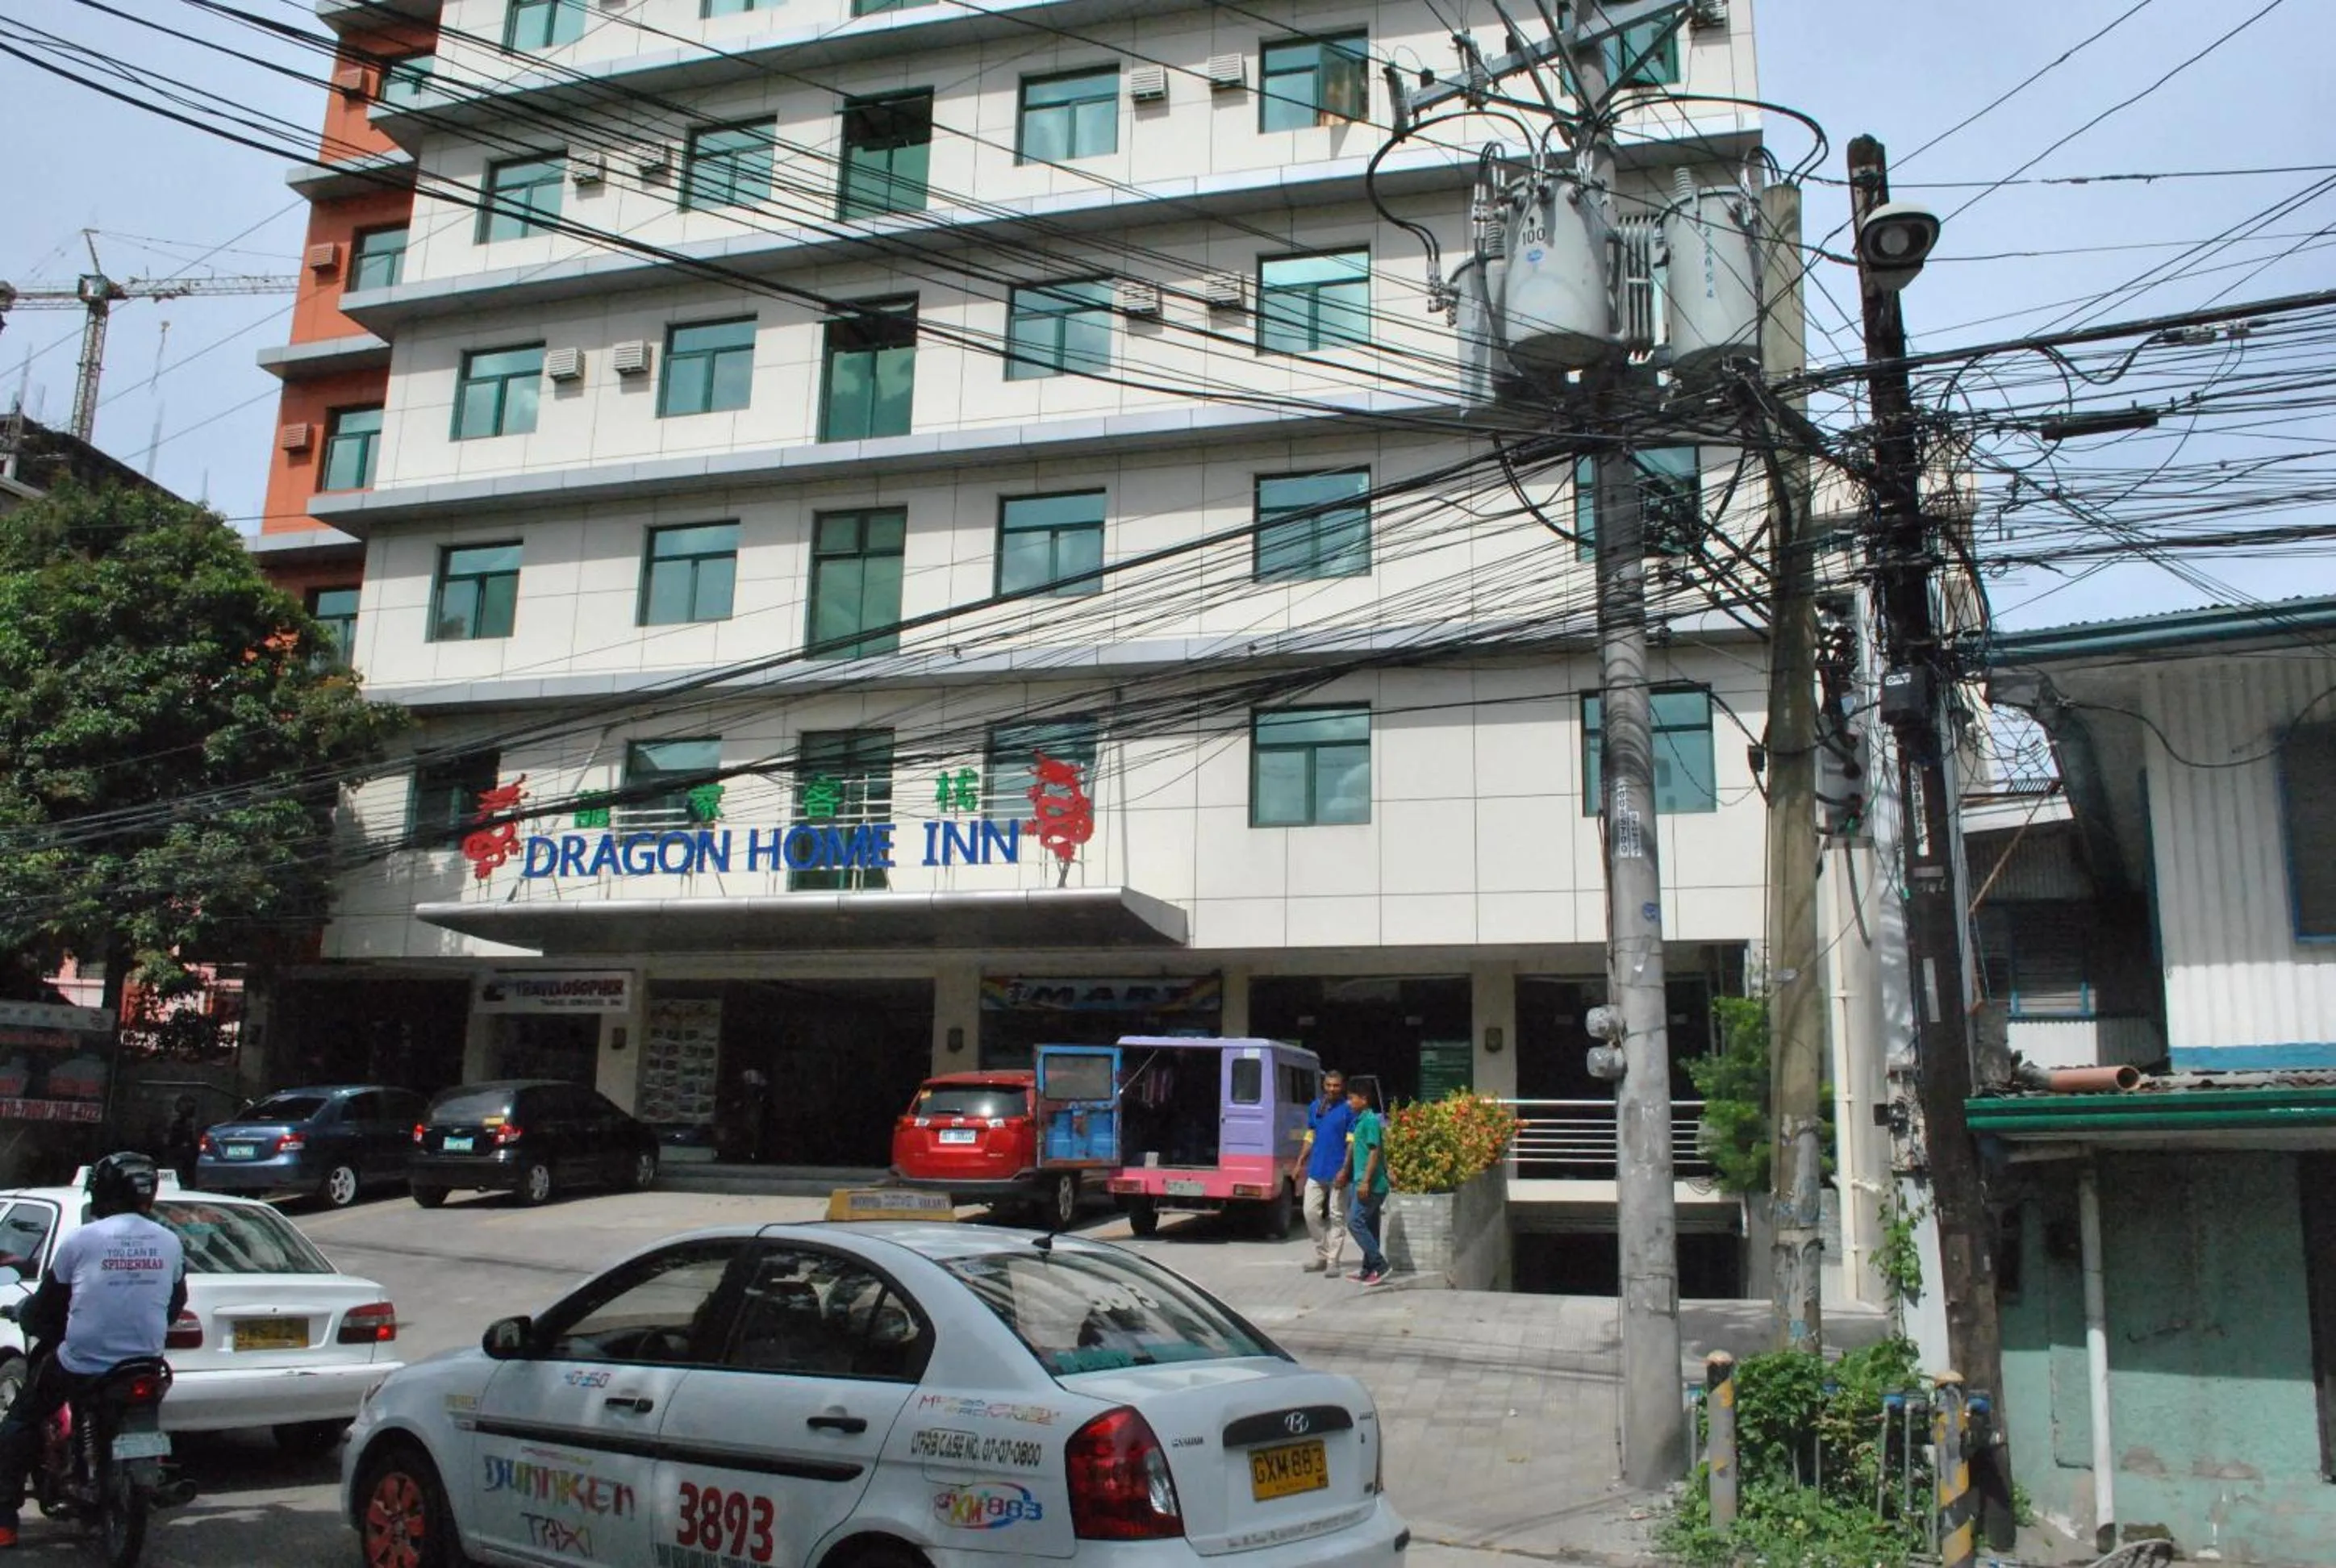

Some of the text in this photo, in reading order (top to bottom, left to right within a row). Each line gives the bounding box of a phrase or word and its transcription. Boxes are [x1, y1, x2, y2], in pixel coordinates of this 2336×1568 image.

[1522, 227, 1546, 246] 100
[524, 819, 1019, 878] DRAGON HOME INN
[677, 1481, 774, 1562] 3893
